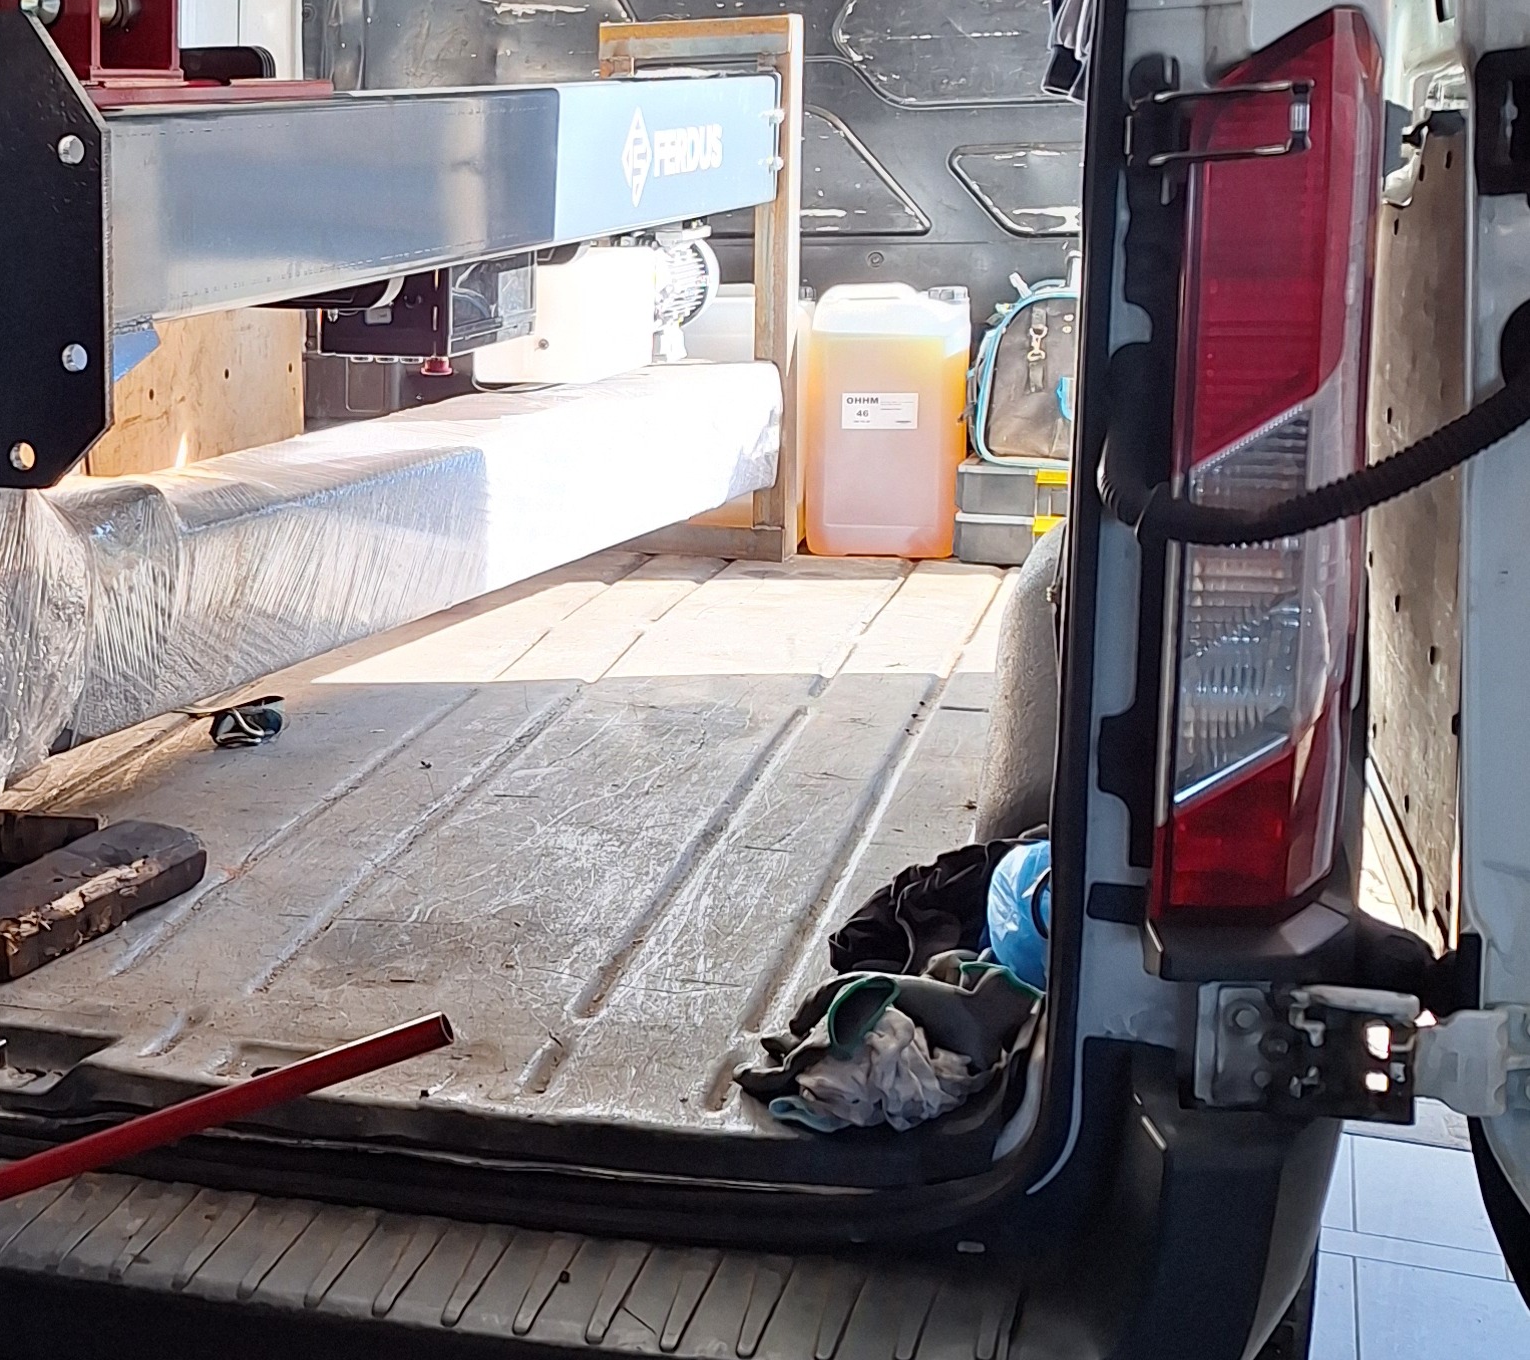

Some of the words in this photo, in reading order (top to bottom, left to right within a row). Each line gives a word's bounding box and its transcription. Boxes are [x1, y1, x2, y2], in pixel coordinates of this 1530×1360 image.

[653, 123, 723, 178] FERDUS
[846, 396, 879, 405] OHHM
[856, 409, 869, 417] 46
